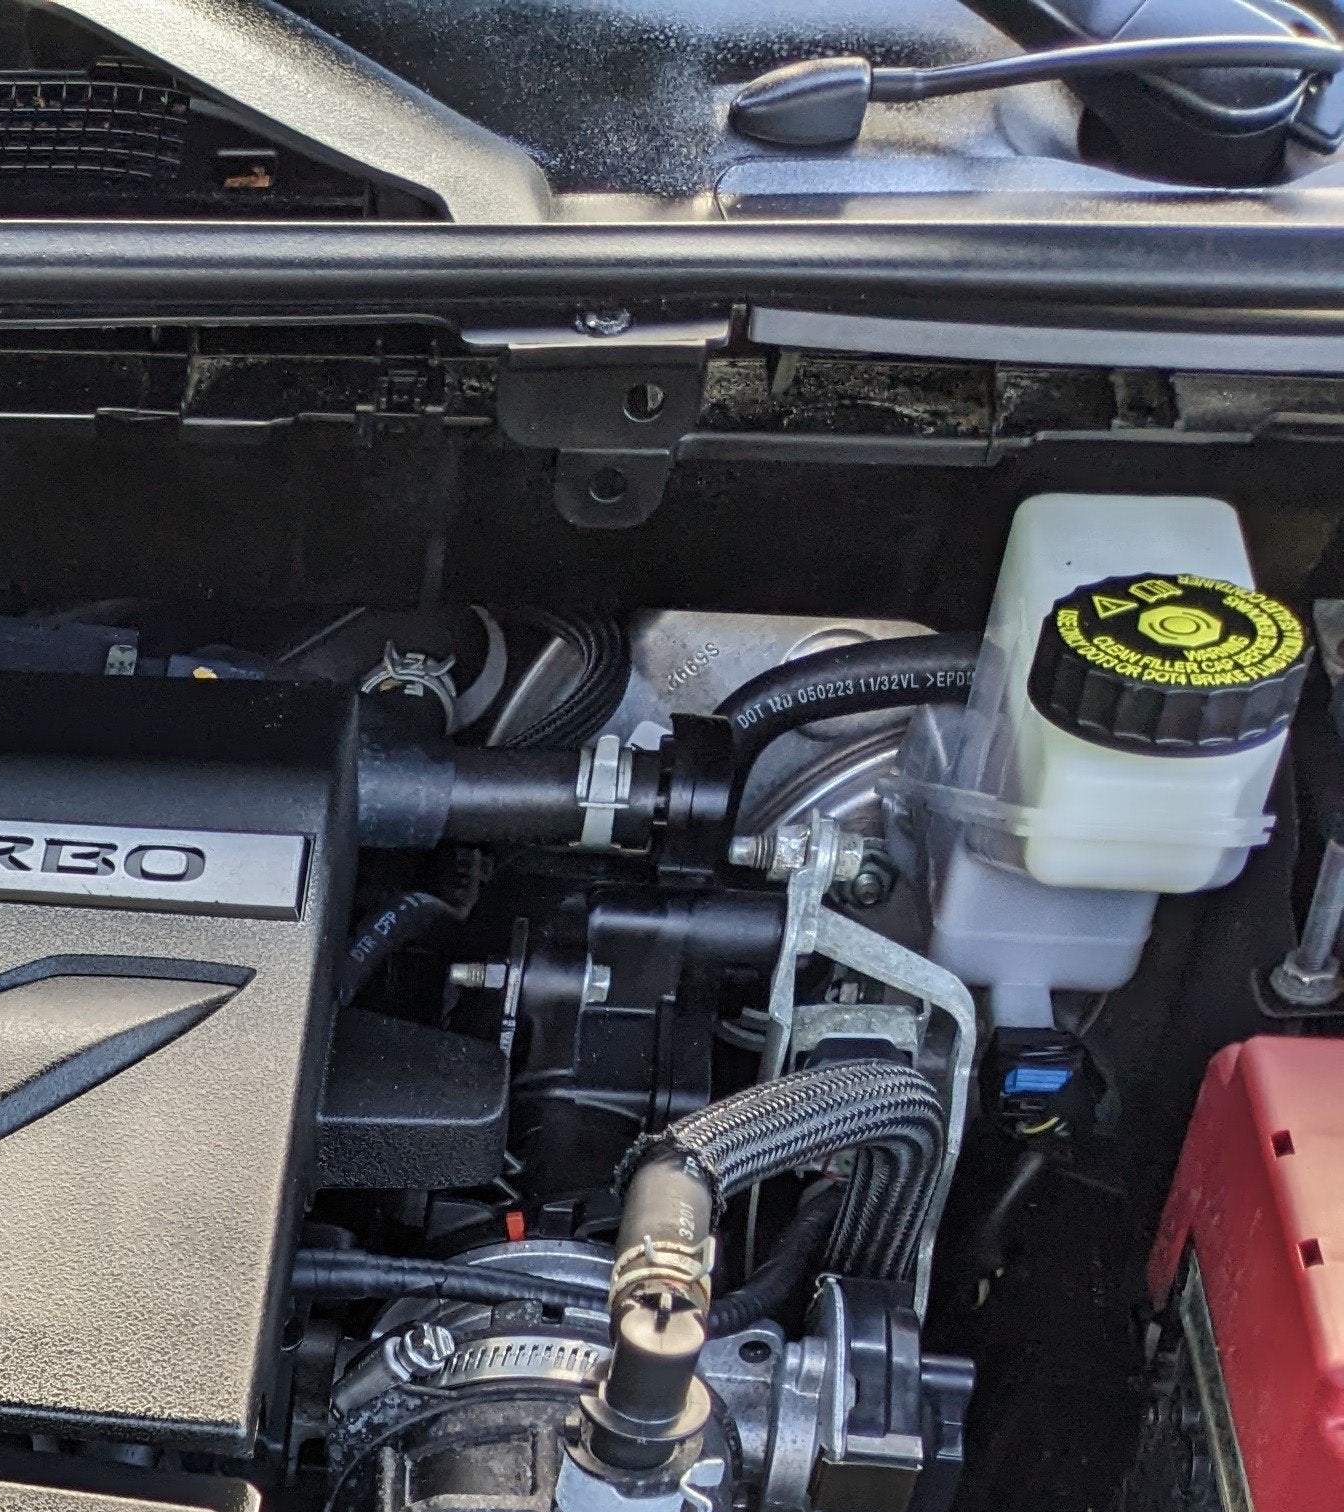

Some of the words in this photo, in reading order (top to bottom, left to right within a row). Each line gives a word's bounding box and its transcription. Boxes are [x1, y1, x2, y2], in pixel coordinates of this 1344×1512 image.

[1177, 574, 1267, 603] CONTAINER
[1083, 646, 1116, 669] DOT3
[1093, 636, 1140, 663] CLEAN
[1140, 656, 1198, 674] FILLER
[1202, 659, 1235, 673] CAP
[1115, 662, 1138, 677] OR
[1142, 669, 1187, 685] DOT4
[1190, 668, 1249, 686] BRAKE
[737, 704, 767, 729] DOT
[797, 680, 855, 704] 050223
[859, 672, 920, 693] 11/32VL
